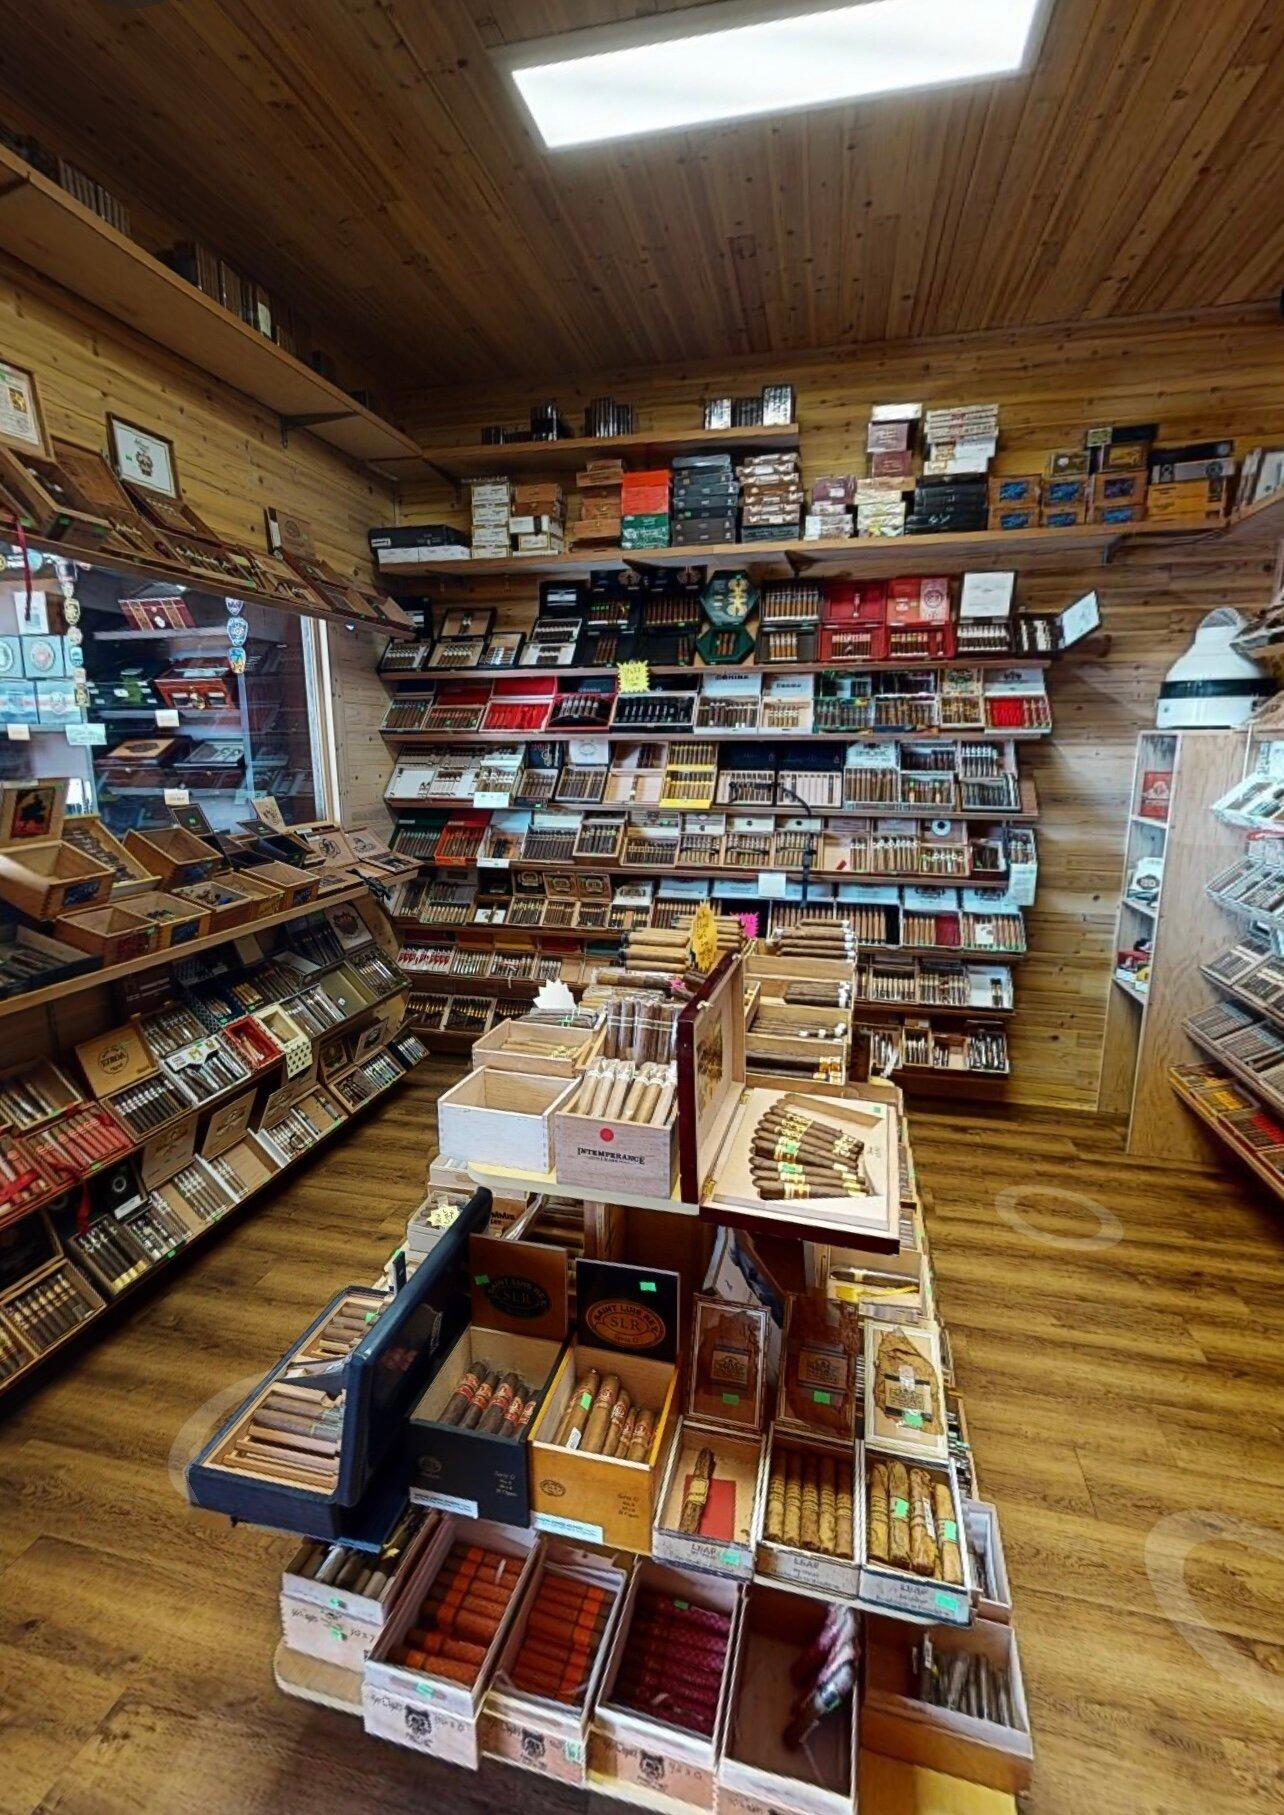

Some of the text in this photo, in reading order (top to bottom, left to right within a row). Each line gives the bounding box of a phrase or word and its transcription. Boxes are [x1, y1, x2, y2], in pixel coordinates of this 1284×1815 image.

[577, 1147, 645, 1164] INTEMPERANCE
[593, 1304, 617, 1322] SAINT
[608, 1317, 641, 1331] SLR
